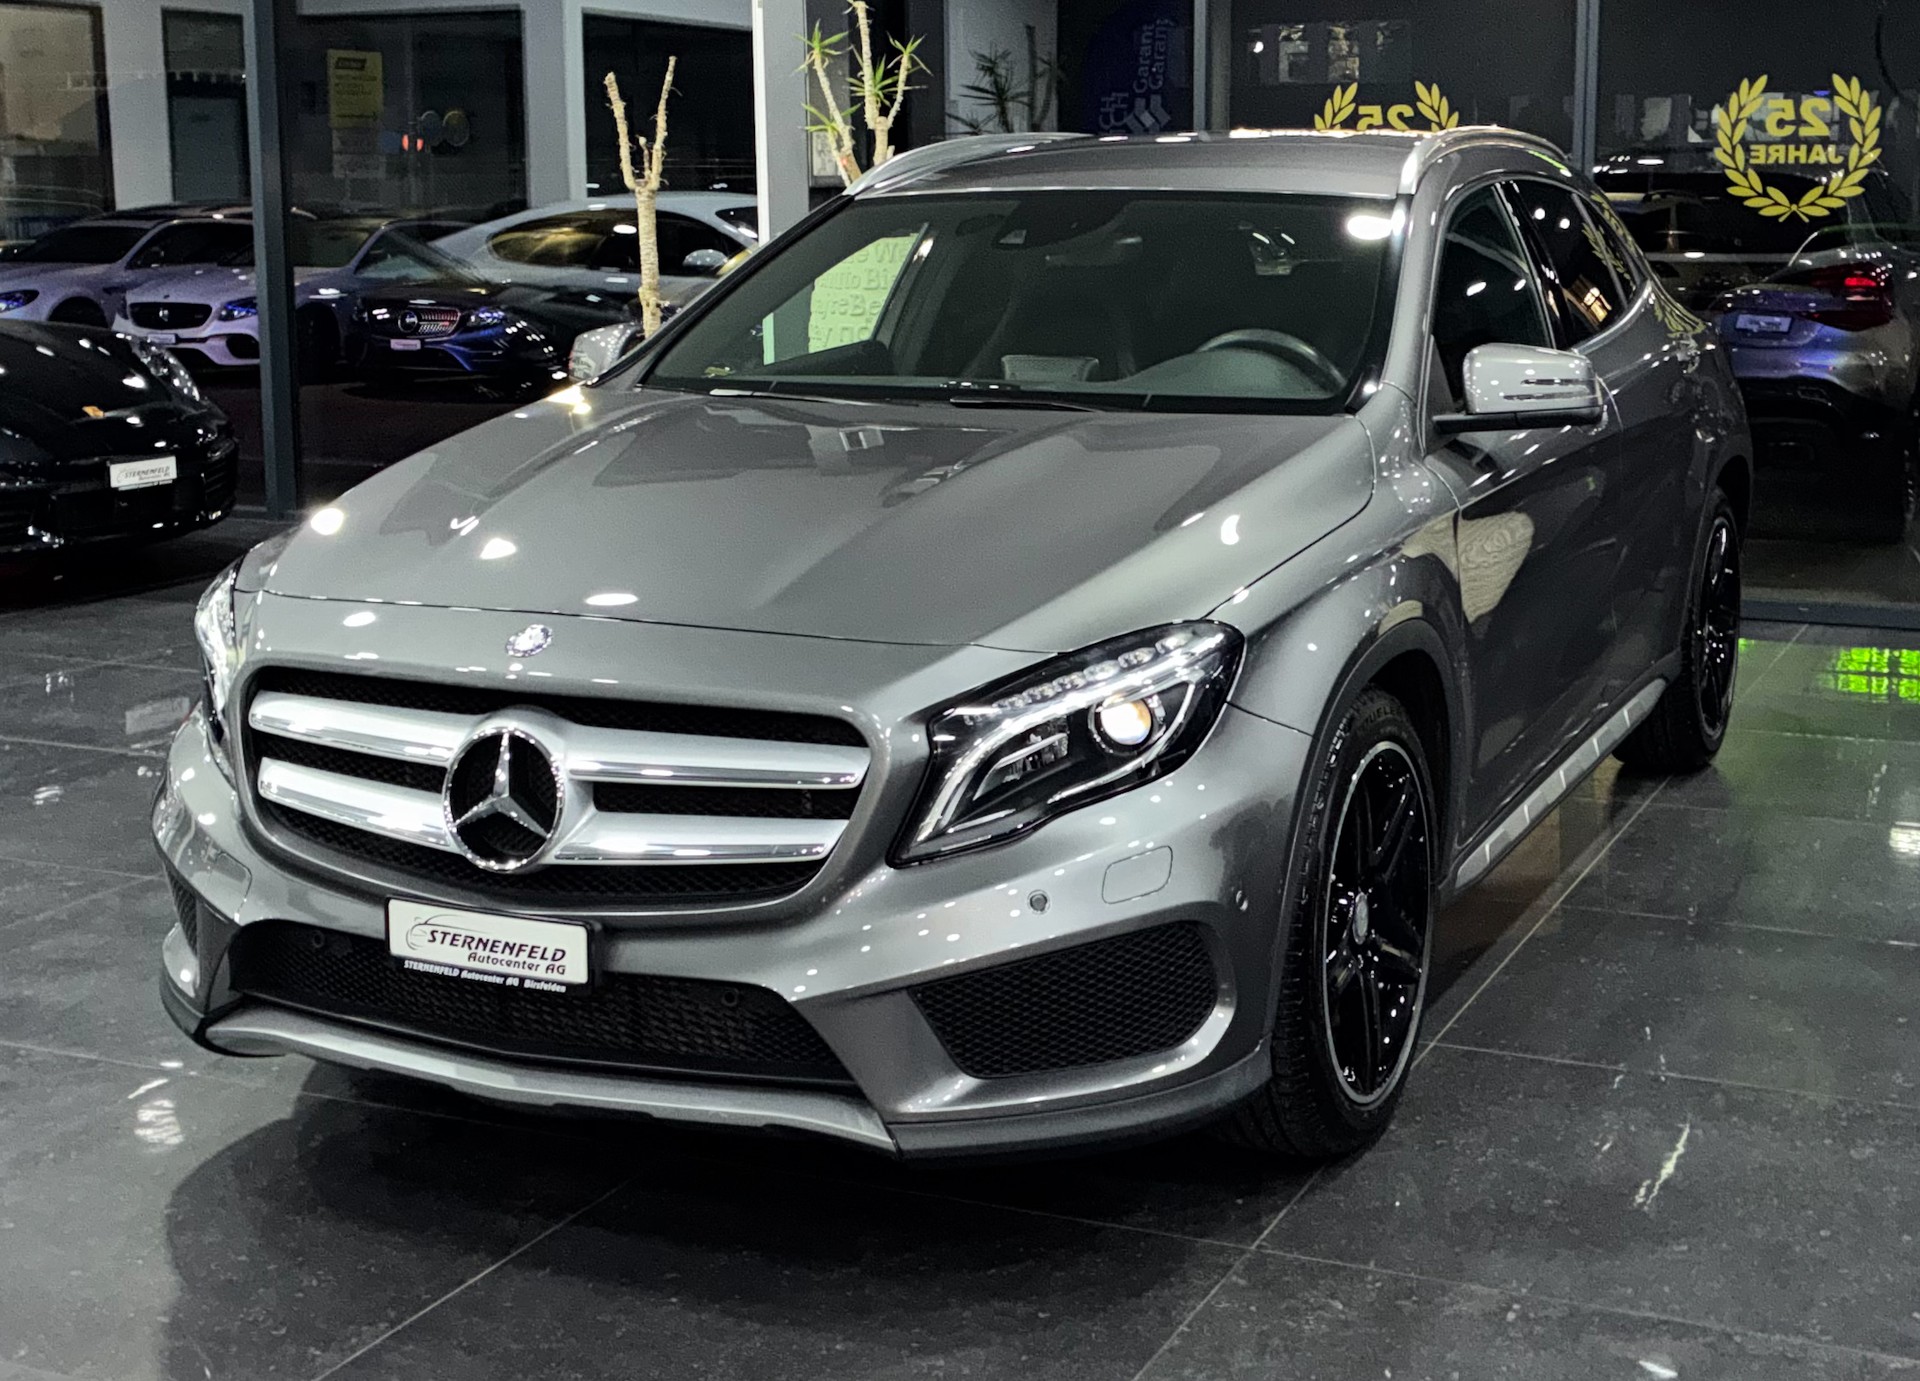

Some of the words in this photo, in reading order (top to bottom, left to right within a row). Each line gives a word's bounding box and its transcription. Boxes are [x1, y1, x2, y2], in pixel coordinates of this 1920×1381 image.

[427, 929, 566, 962] STERNENFELD
[403, 959, 460, 977] STERNENFELD
[460, 969, 504, 984] Autocenter
[505, 976, 519, 986] AG
[523, 978, 567, 993] Birsfelden
[467, 951, 540, 971] Autocenter
[545, 963, 566, 975] AG
